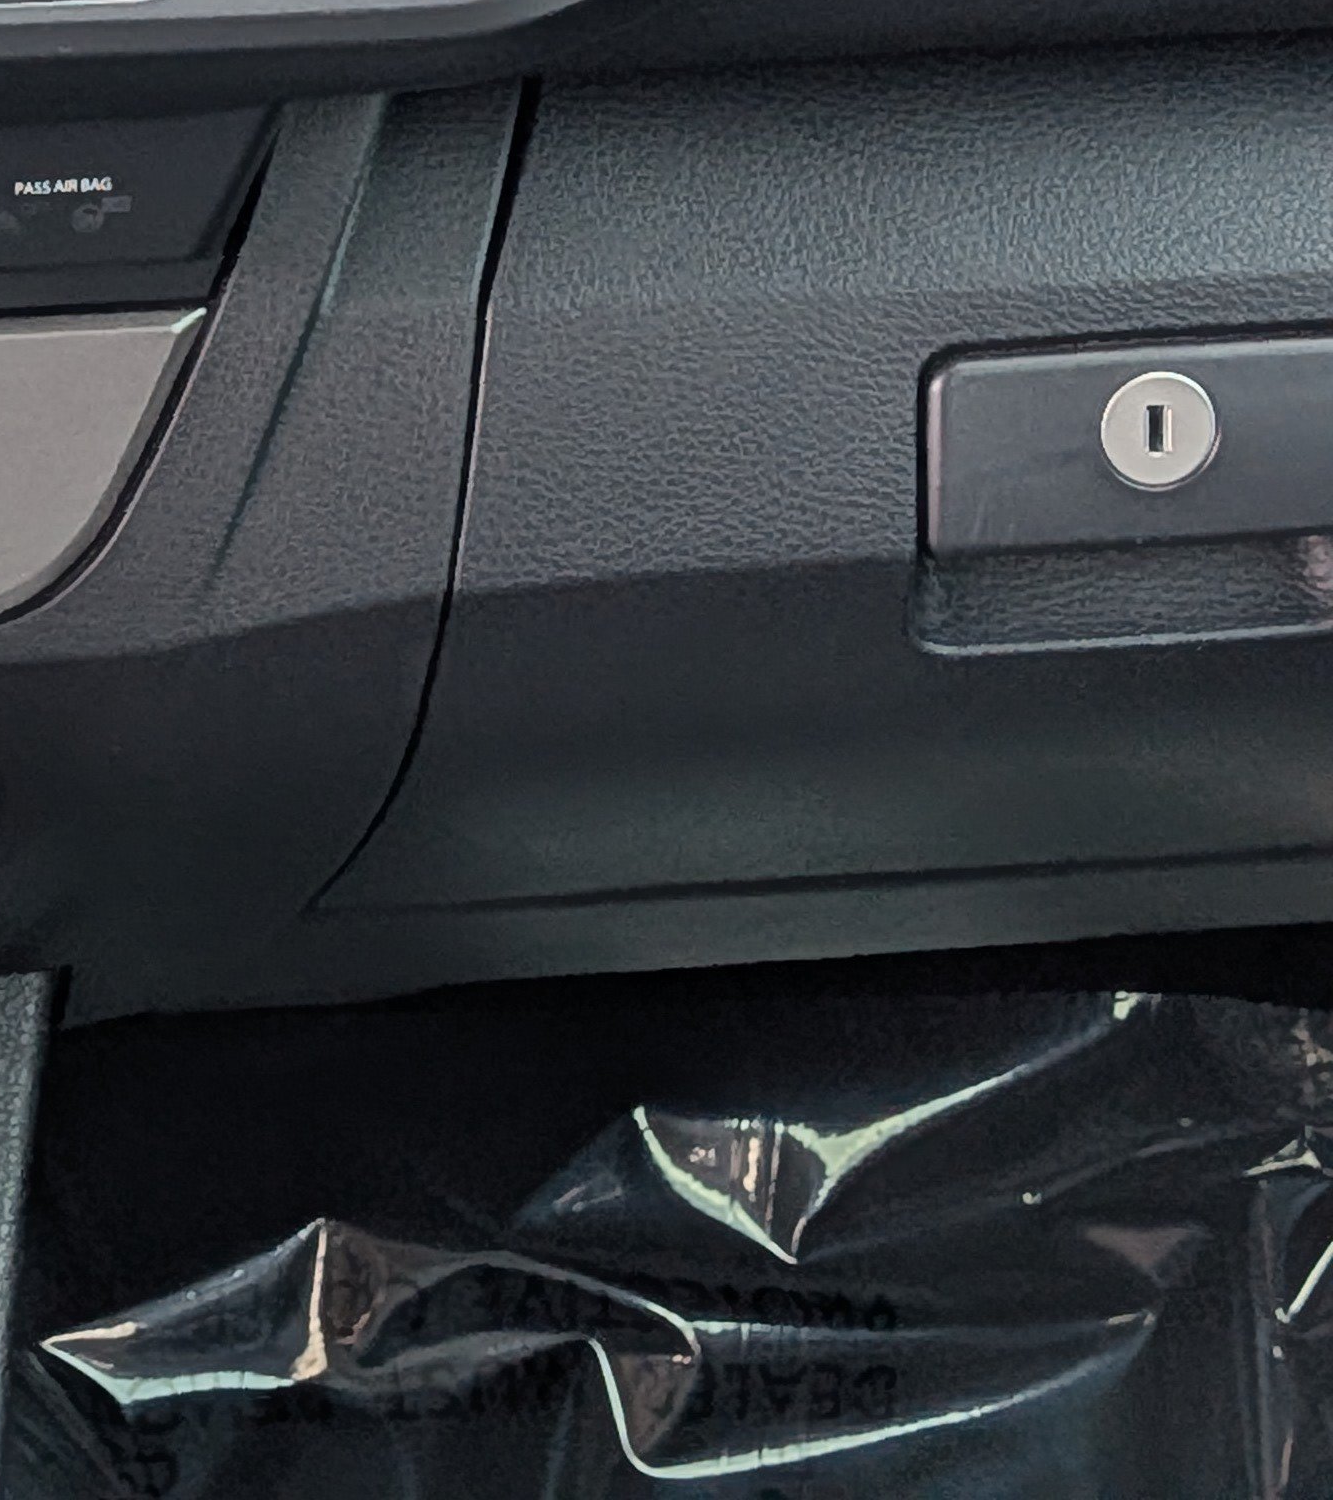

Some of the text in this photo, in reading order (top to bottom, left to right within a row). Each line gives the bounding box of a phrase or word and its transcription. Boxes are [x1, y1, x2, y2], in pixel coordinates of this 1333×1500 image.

[14, 176, 113, 196] PASS AIR BAG
